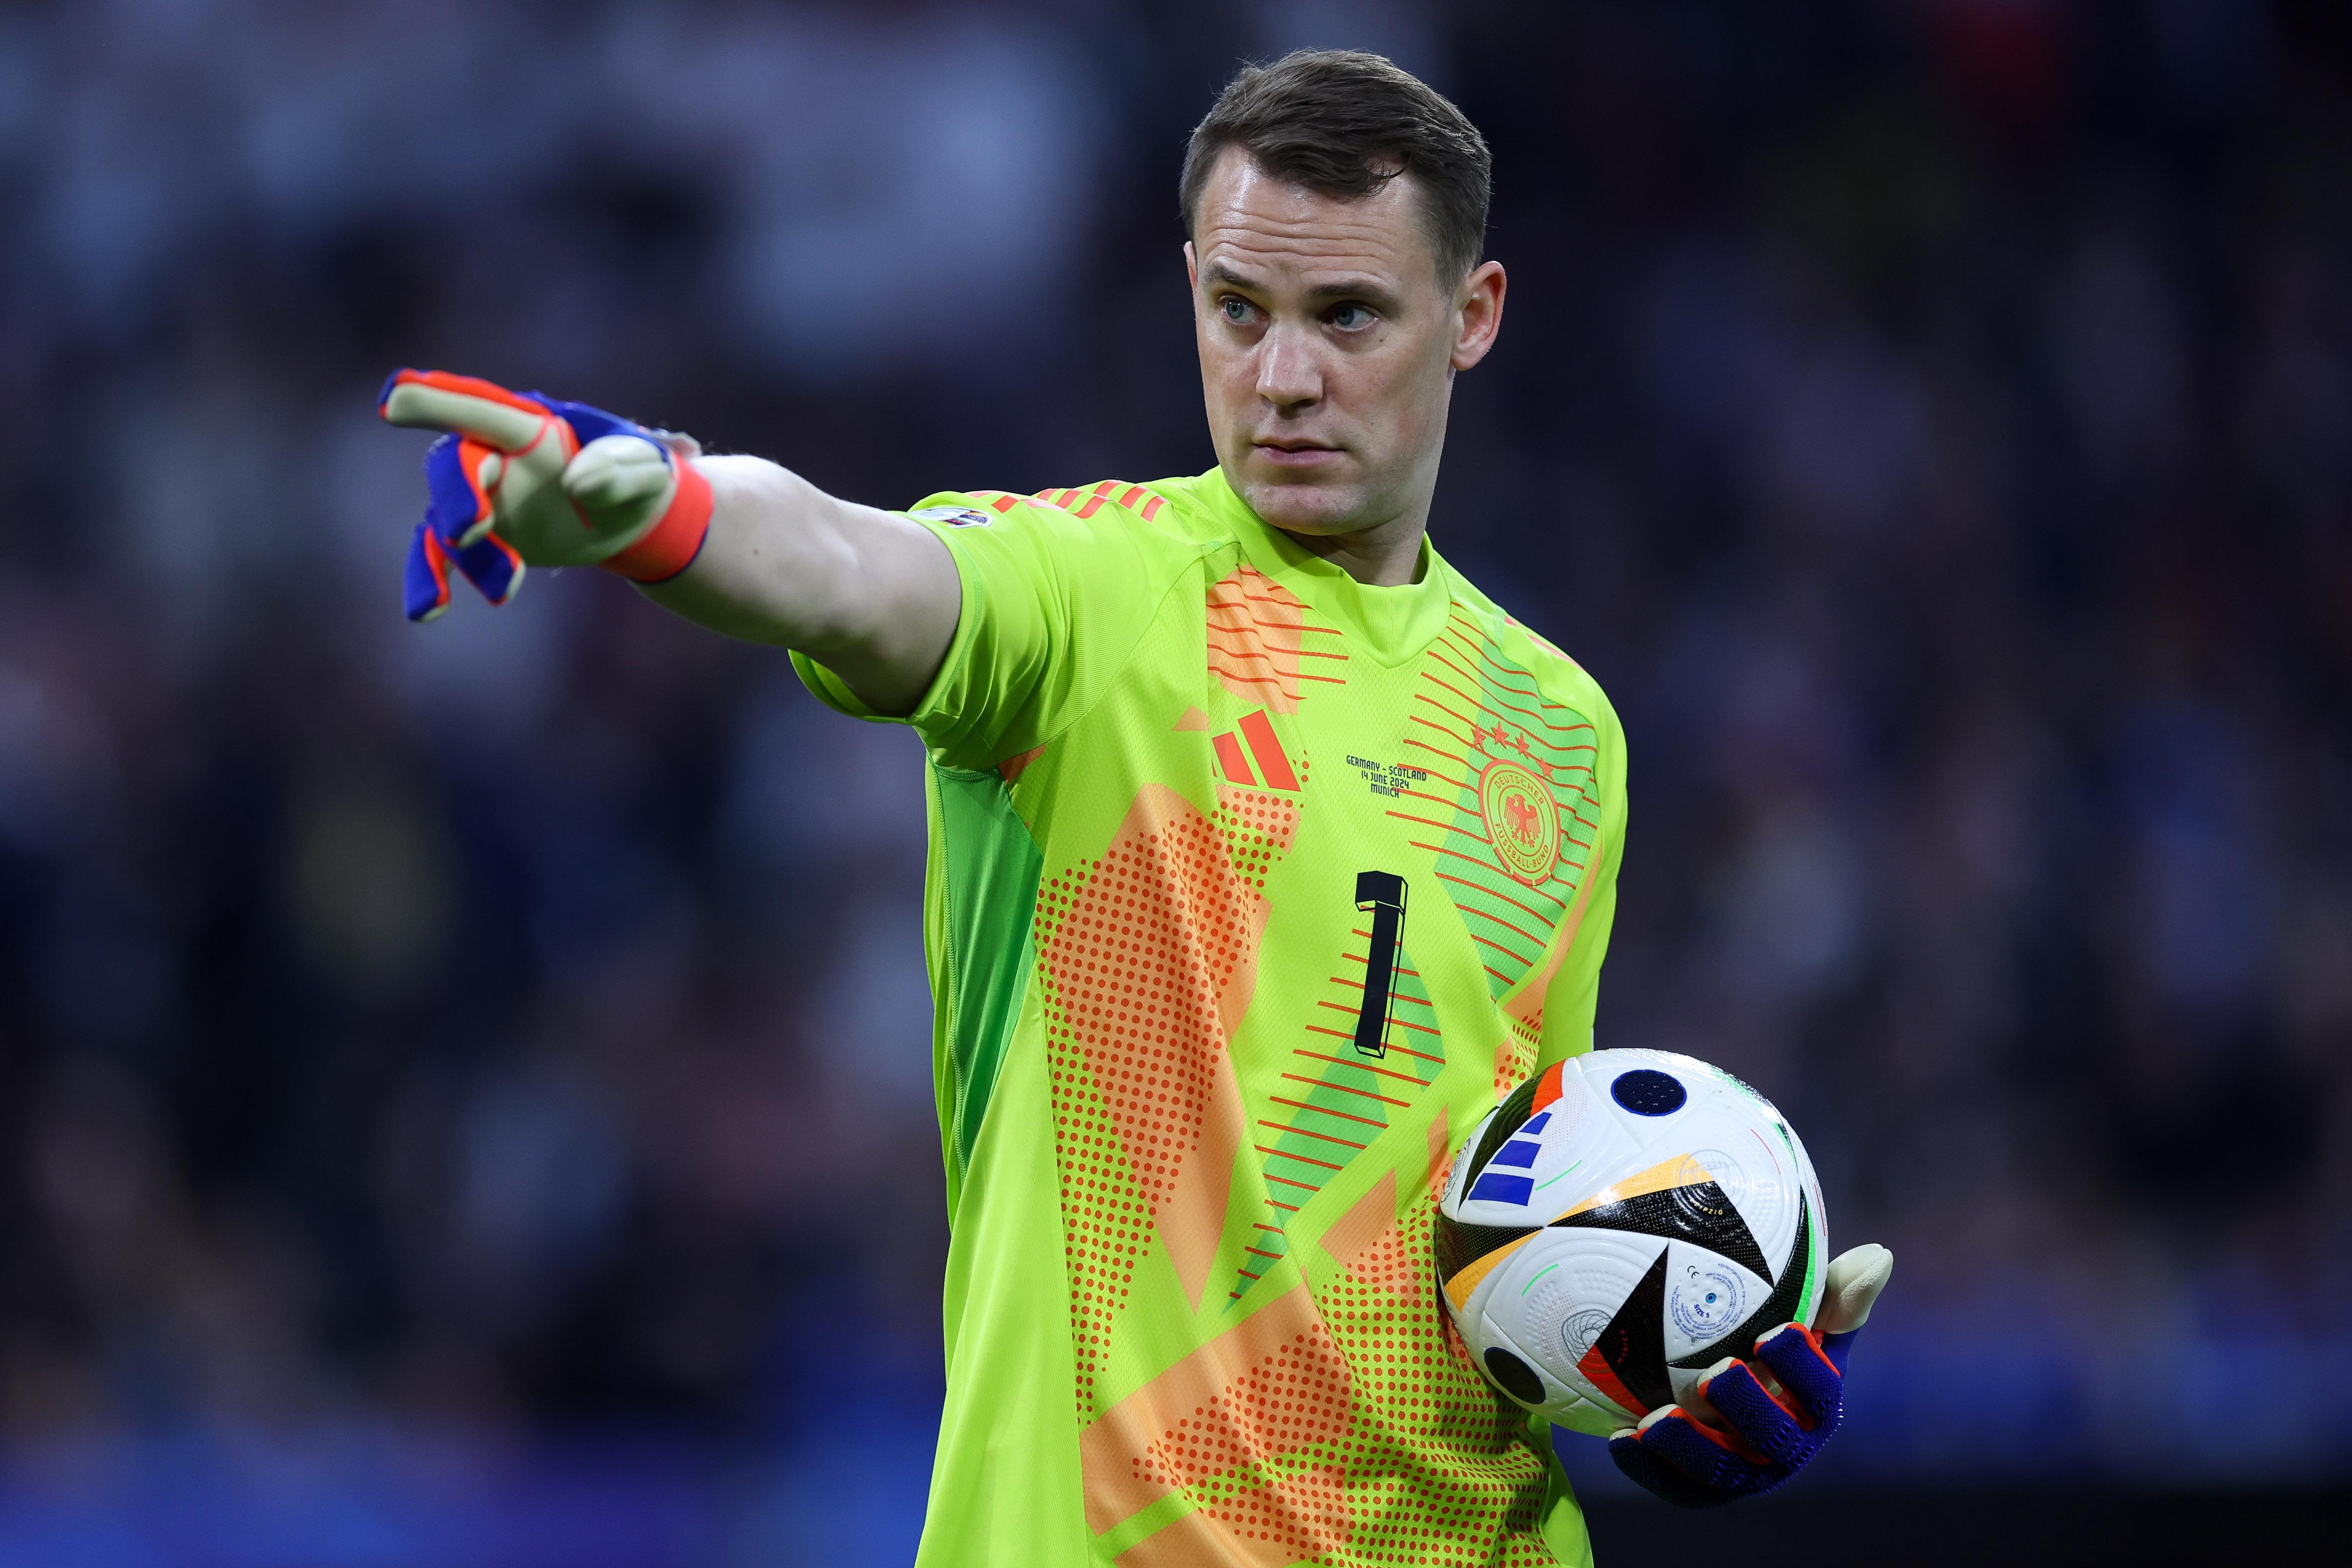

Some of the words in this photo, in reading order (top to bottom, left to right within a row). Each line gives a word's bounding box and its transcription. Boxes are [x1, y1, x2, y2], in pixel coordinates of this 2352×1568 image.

[1346, 755, 1379, 772] GERMANY
[1389, 766, 1427, 781] SCOTLAND
[1361, 770, 1368, 780] 14
[1371, 773, 1388, 785] JUNE
[1390, 777, 1409, 789] 2024
[1371, 783, 1399, 798] MUNICH
[1494, 775, 1544, 805] DEUTSCHER
[1495, 823, 1549, 868] FUSSBALL-BUND
[1354, 870, 1408, 1059] 1
[1694, 1304, 1705, 1317] SIZE
[1617, 1330, 1628, 1364] MUNICH
